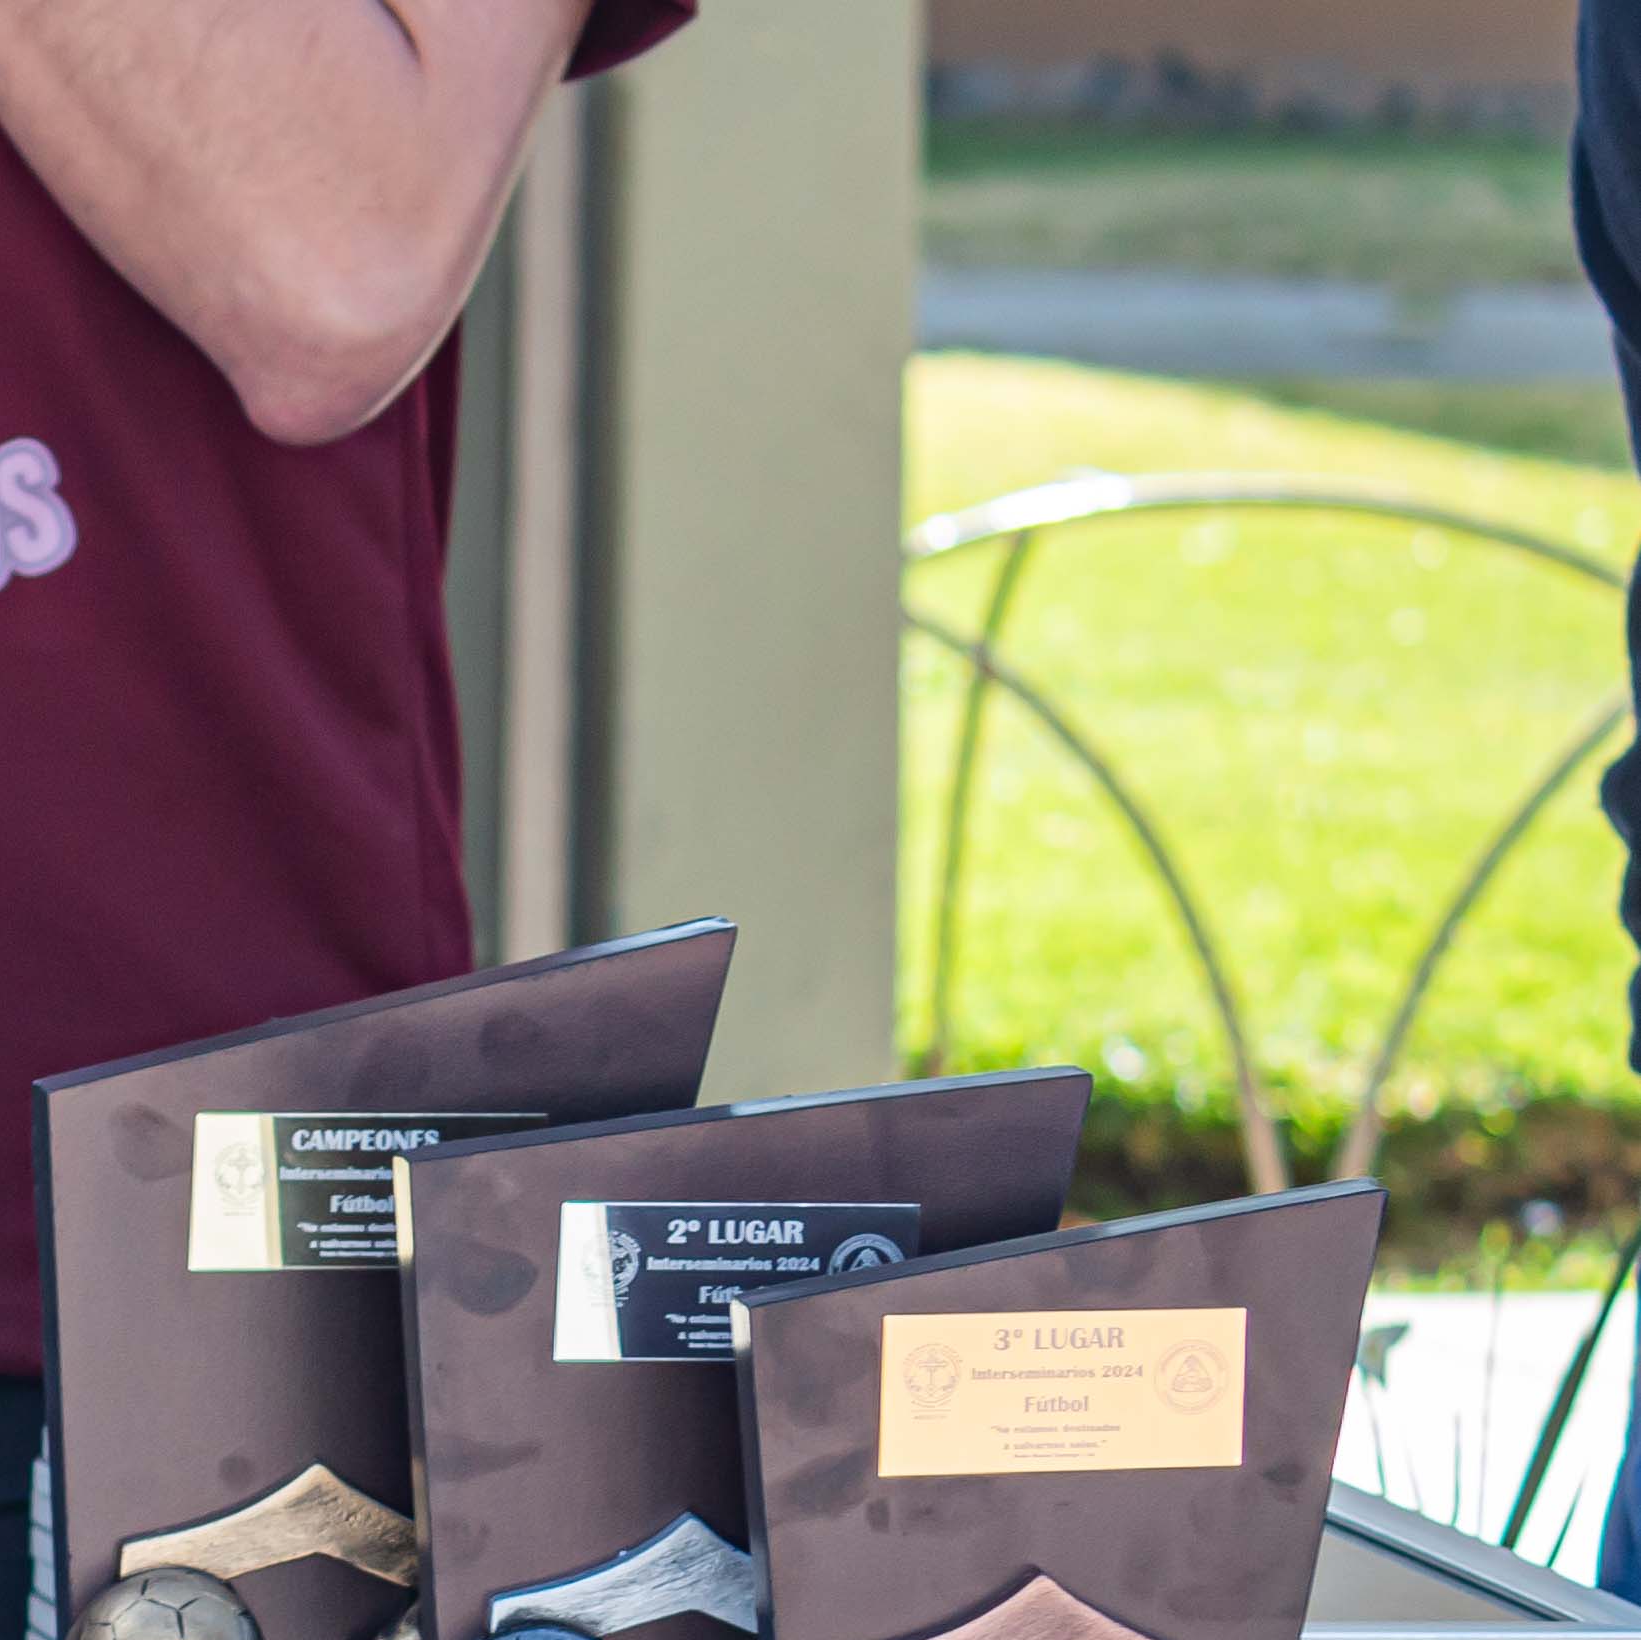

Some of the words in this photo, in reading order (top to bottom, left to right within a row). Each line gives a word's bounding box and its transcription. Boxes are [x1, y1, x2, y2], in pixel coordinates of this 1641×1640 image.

[292, 1129, 439, 1151] CAMPEONES
[707, 1220, 805, 1244] LUGAR
[776, 1256, 820, 1271] 2024
[1033, 1326, 1125, 1351] LUGAR
[971, 1364, 1096, 1380] Interseminarios
[1102, 1364, 1144, 1379] 2024
[1023, 1395, 1090, 1414] Fútbol
